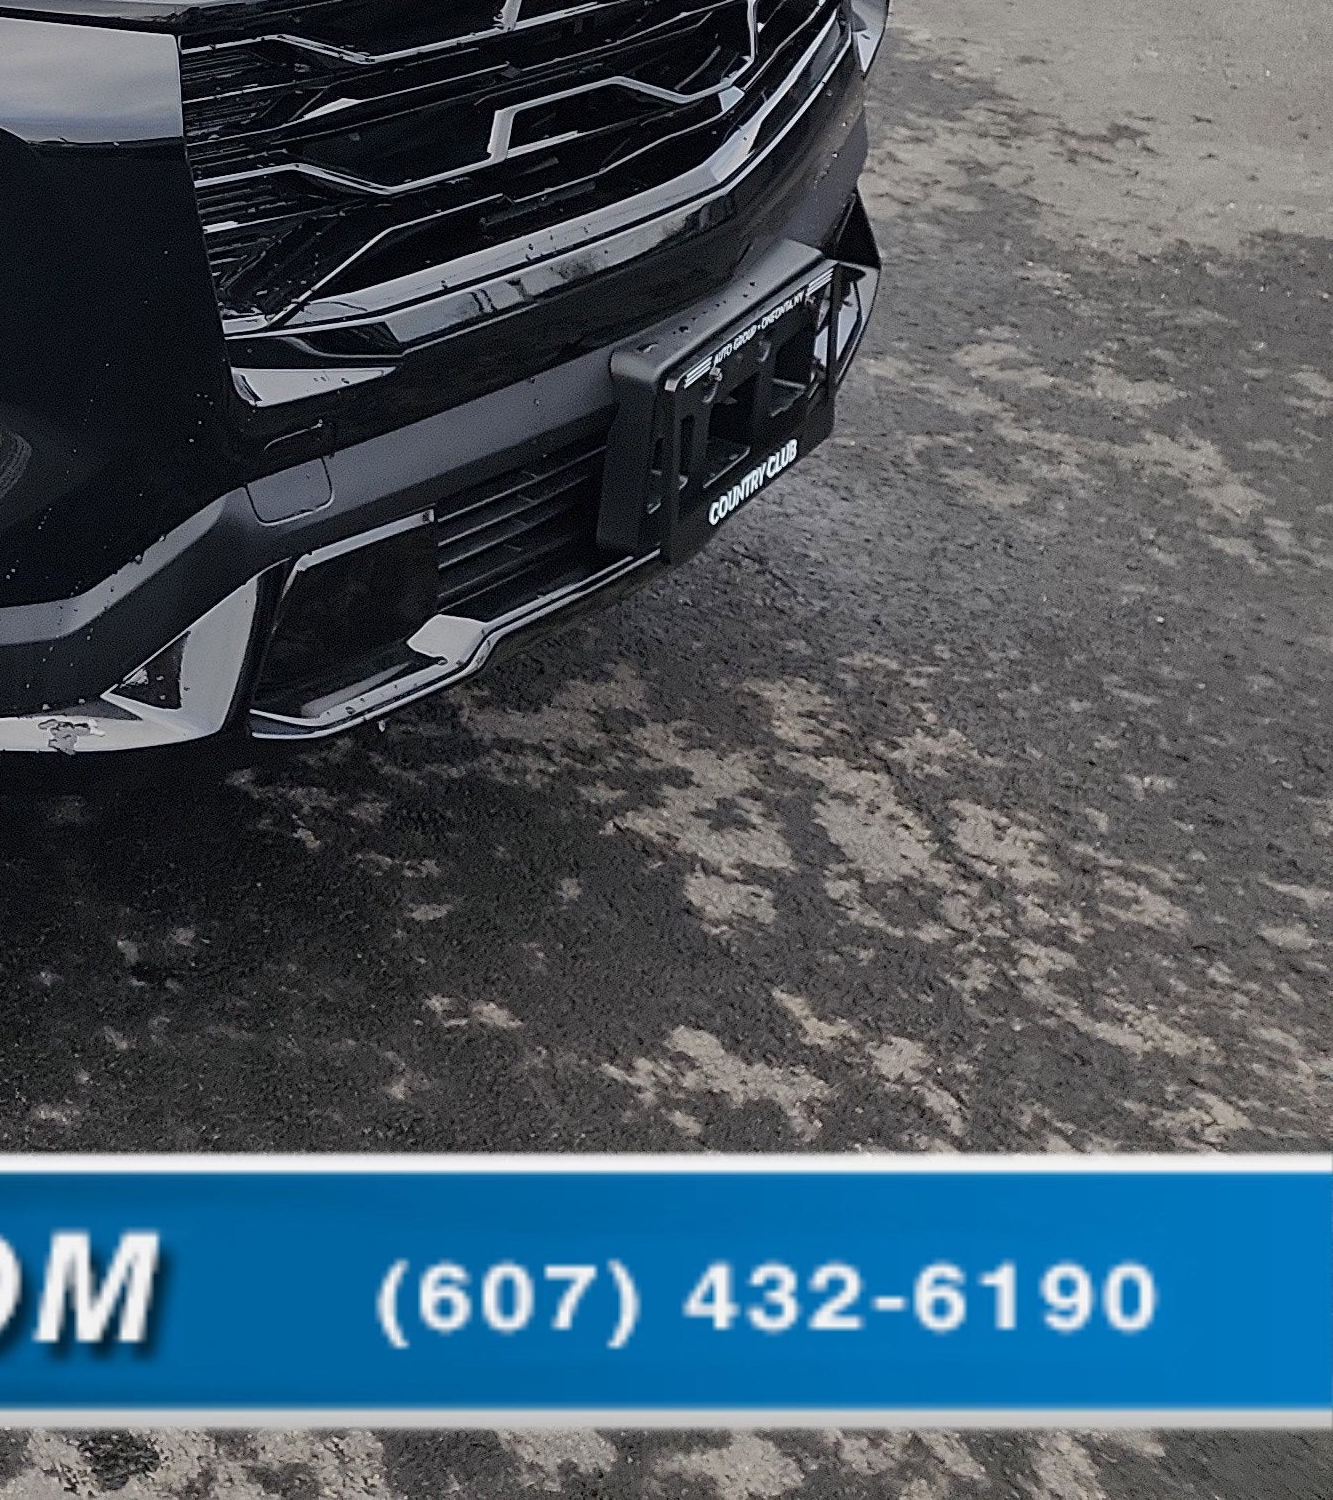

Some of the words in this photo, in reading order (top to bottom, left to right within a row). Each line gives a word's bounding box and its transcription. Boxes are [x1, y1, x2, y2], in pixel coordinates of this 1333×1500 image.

[712, 342, 733, 366] AUTO
[733, 324, 758, 350] GROUP
[708, 461, 767, 526] COUNTRY
[765, 438, 798, 479] CLUB
